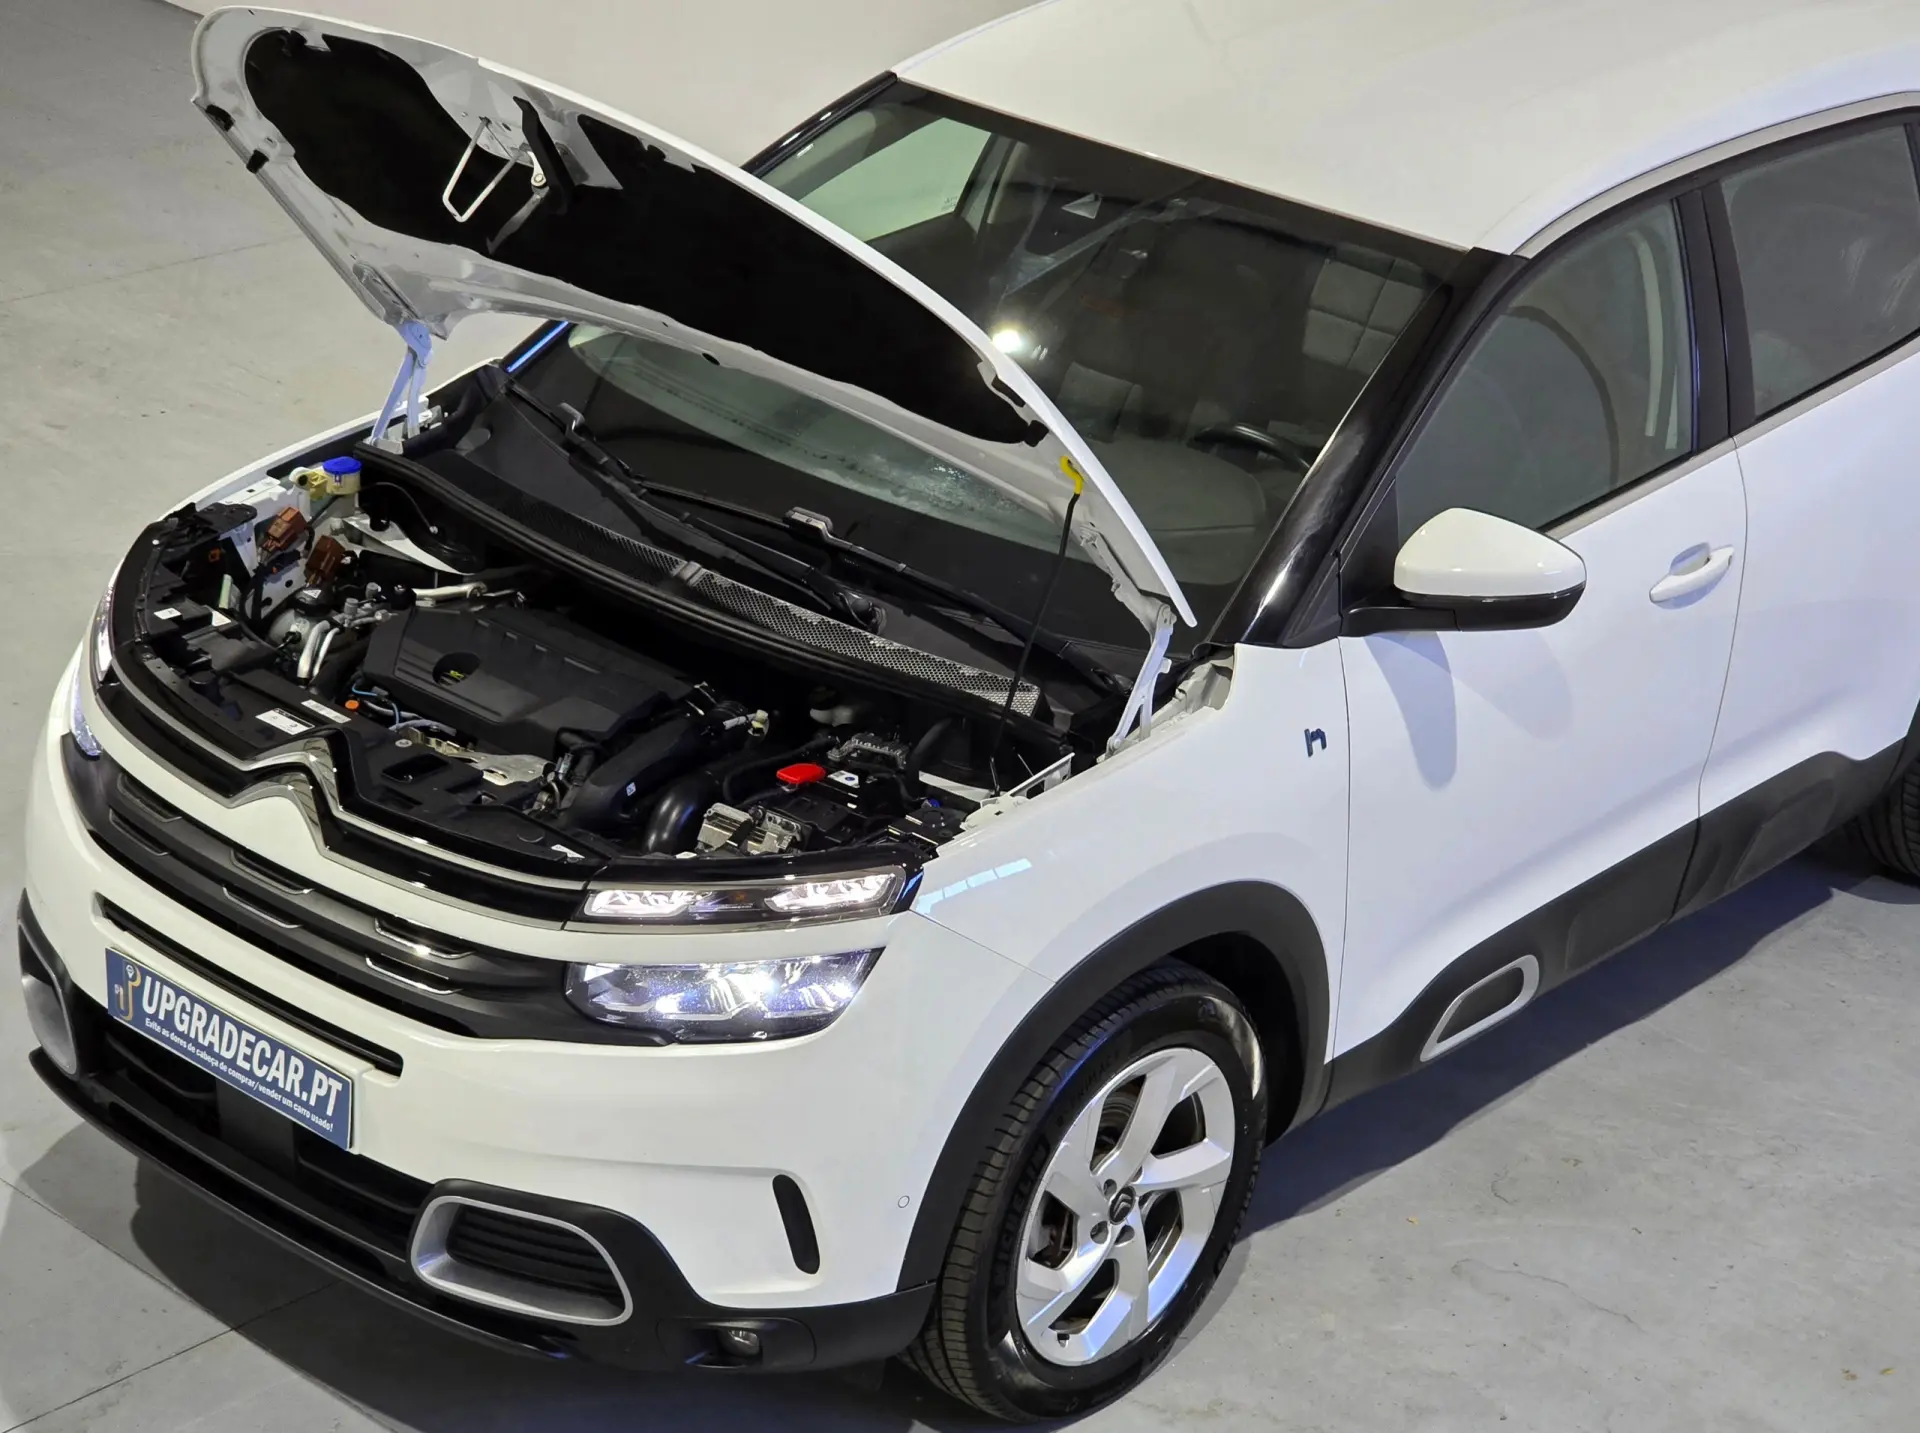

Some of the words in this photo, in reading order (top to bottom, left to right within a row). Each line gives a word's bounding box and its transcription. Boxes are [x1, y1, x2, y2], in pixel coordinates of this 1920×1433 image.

[142, 975, 343, 1117] UPGRADECAR.PT
[161, 1028, 170, 1038] as
[170, 1032, 187, 1048] dores
[187, 1043, 196, 1053] de
[196, 1049, 219, 1067] cabeça
[219, 1062, 228, 1072] de
[282, 1097, 293, 1108] um
[293, 1103, 311, 1118] carro
[311, 1114, 334, 1132] usado!
